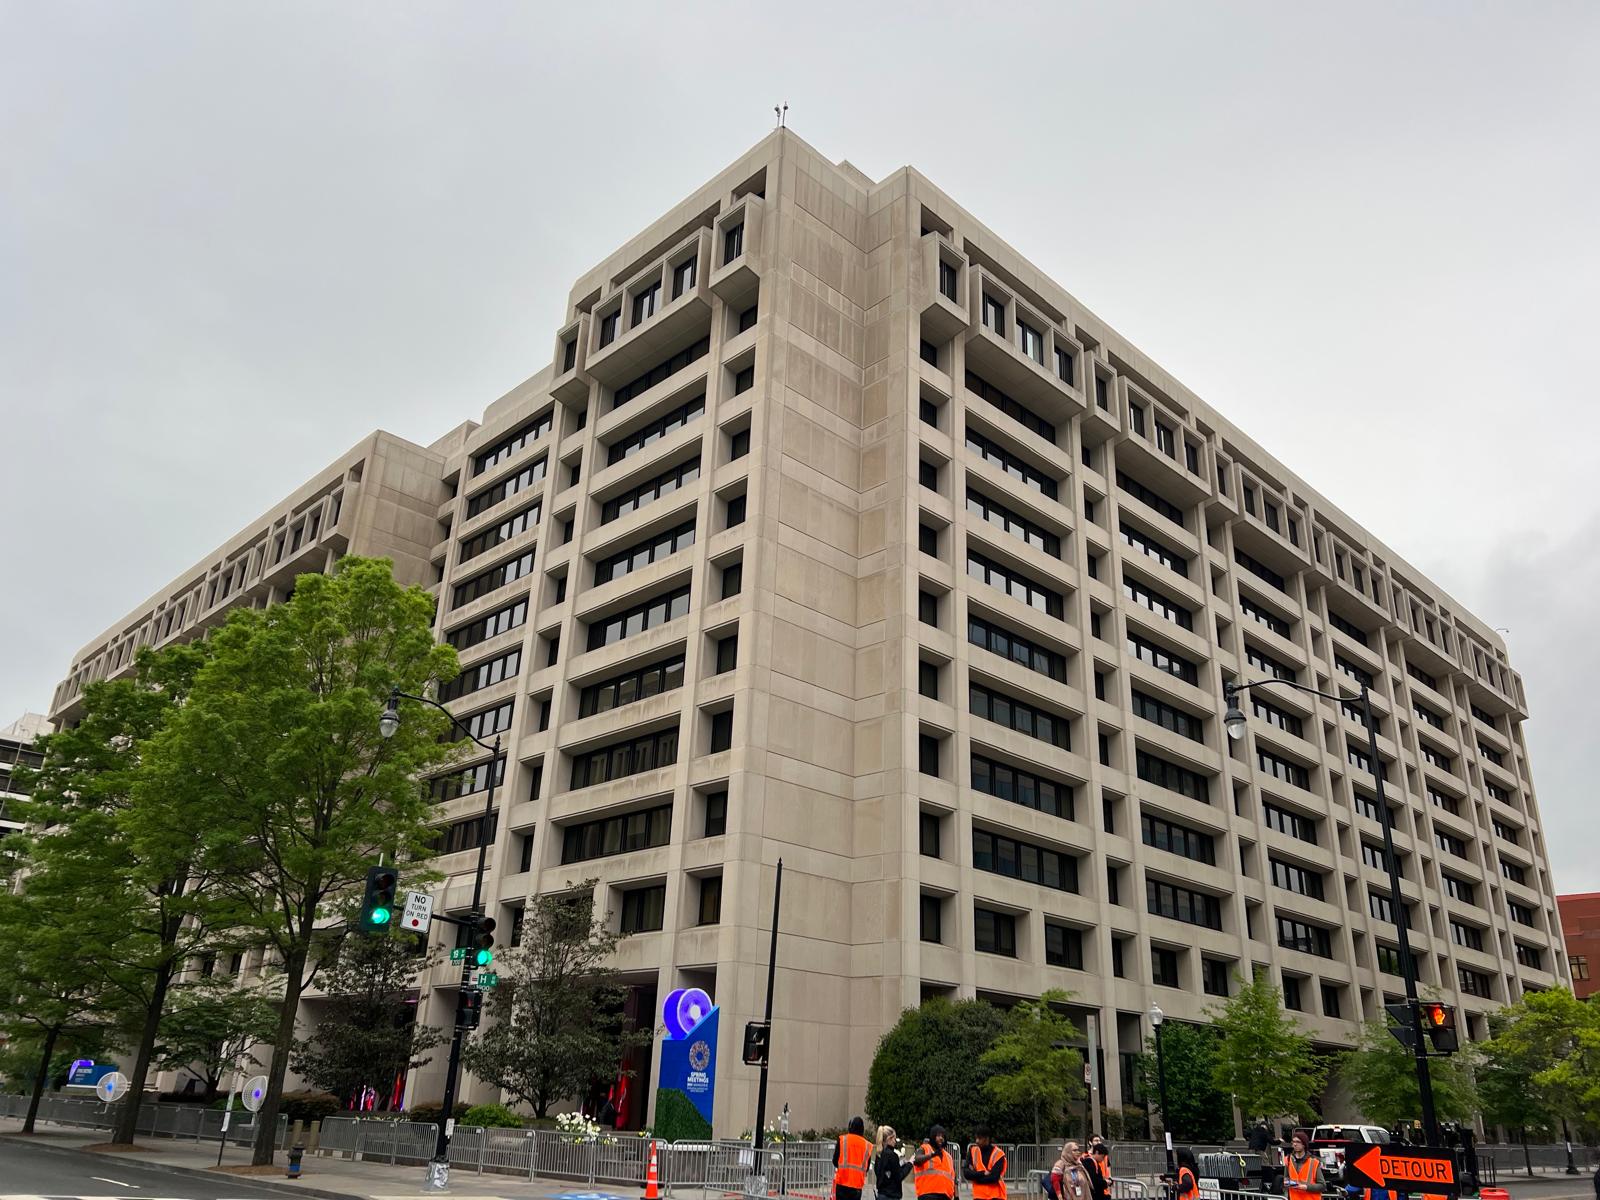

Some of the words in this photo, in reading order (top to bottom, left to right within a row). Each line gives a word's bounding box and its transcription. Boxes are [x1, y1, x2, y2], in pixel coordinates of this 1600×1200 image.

[414, 895, 426, 904] NO
[412, 903, 426, 912] TURN
[416, 912, 428, 920] RED
[1380, 1159, 1447, 1180] DETOUR
